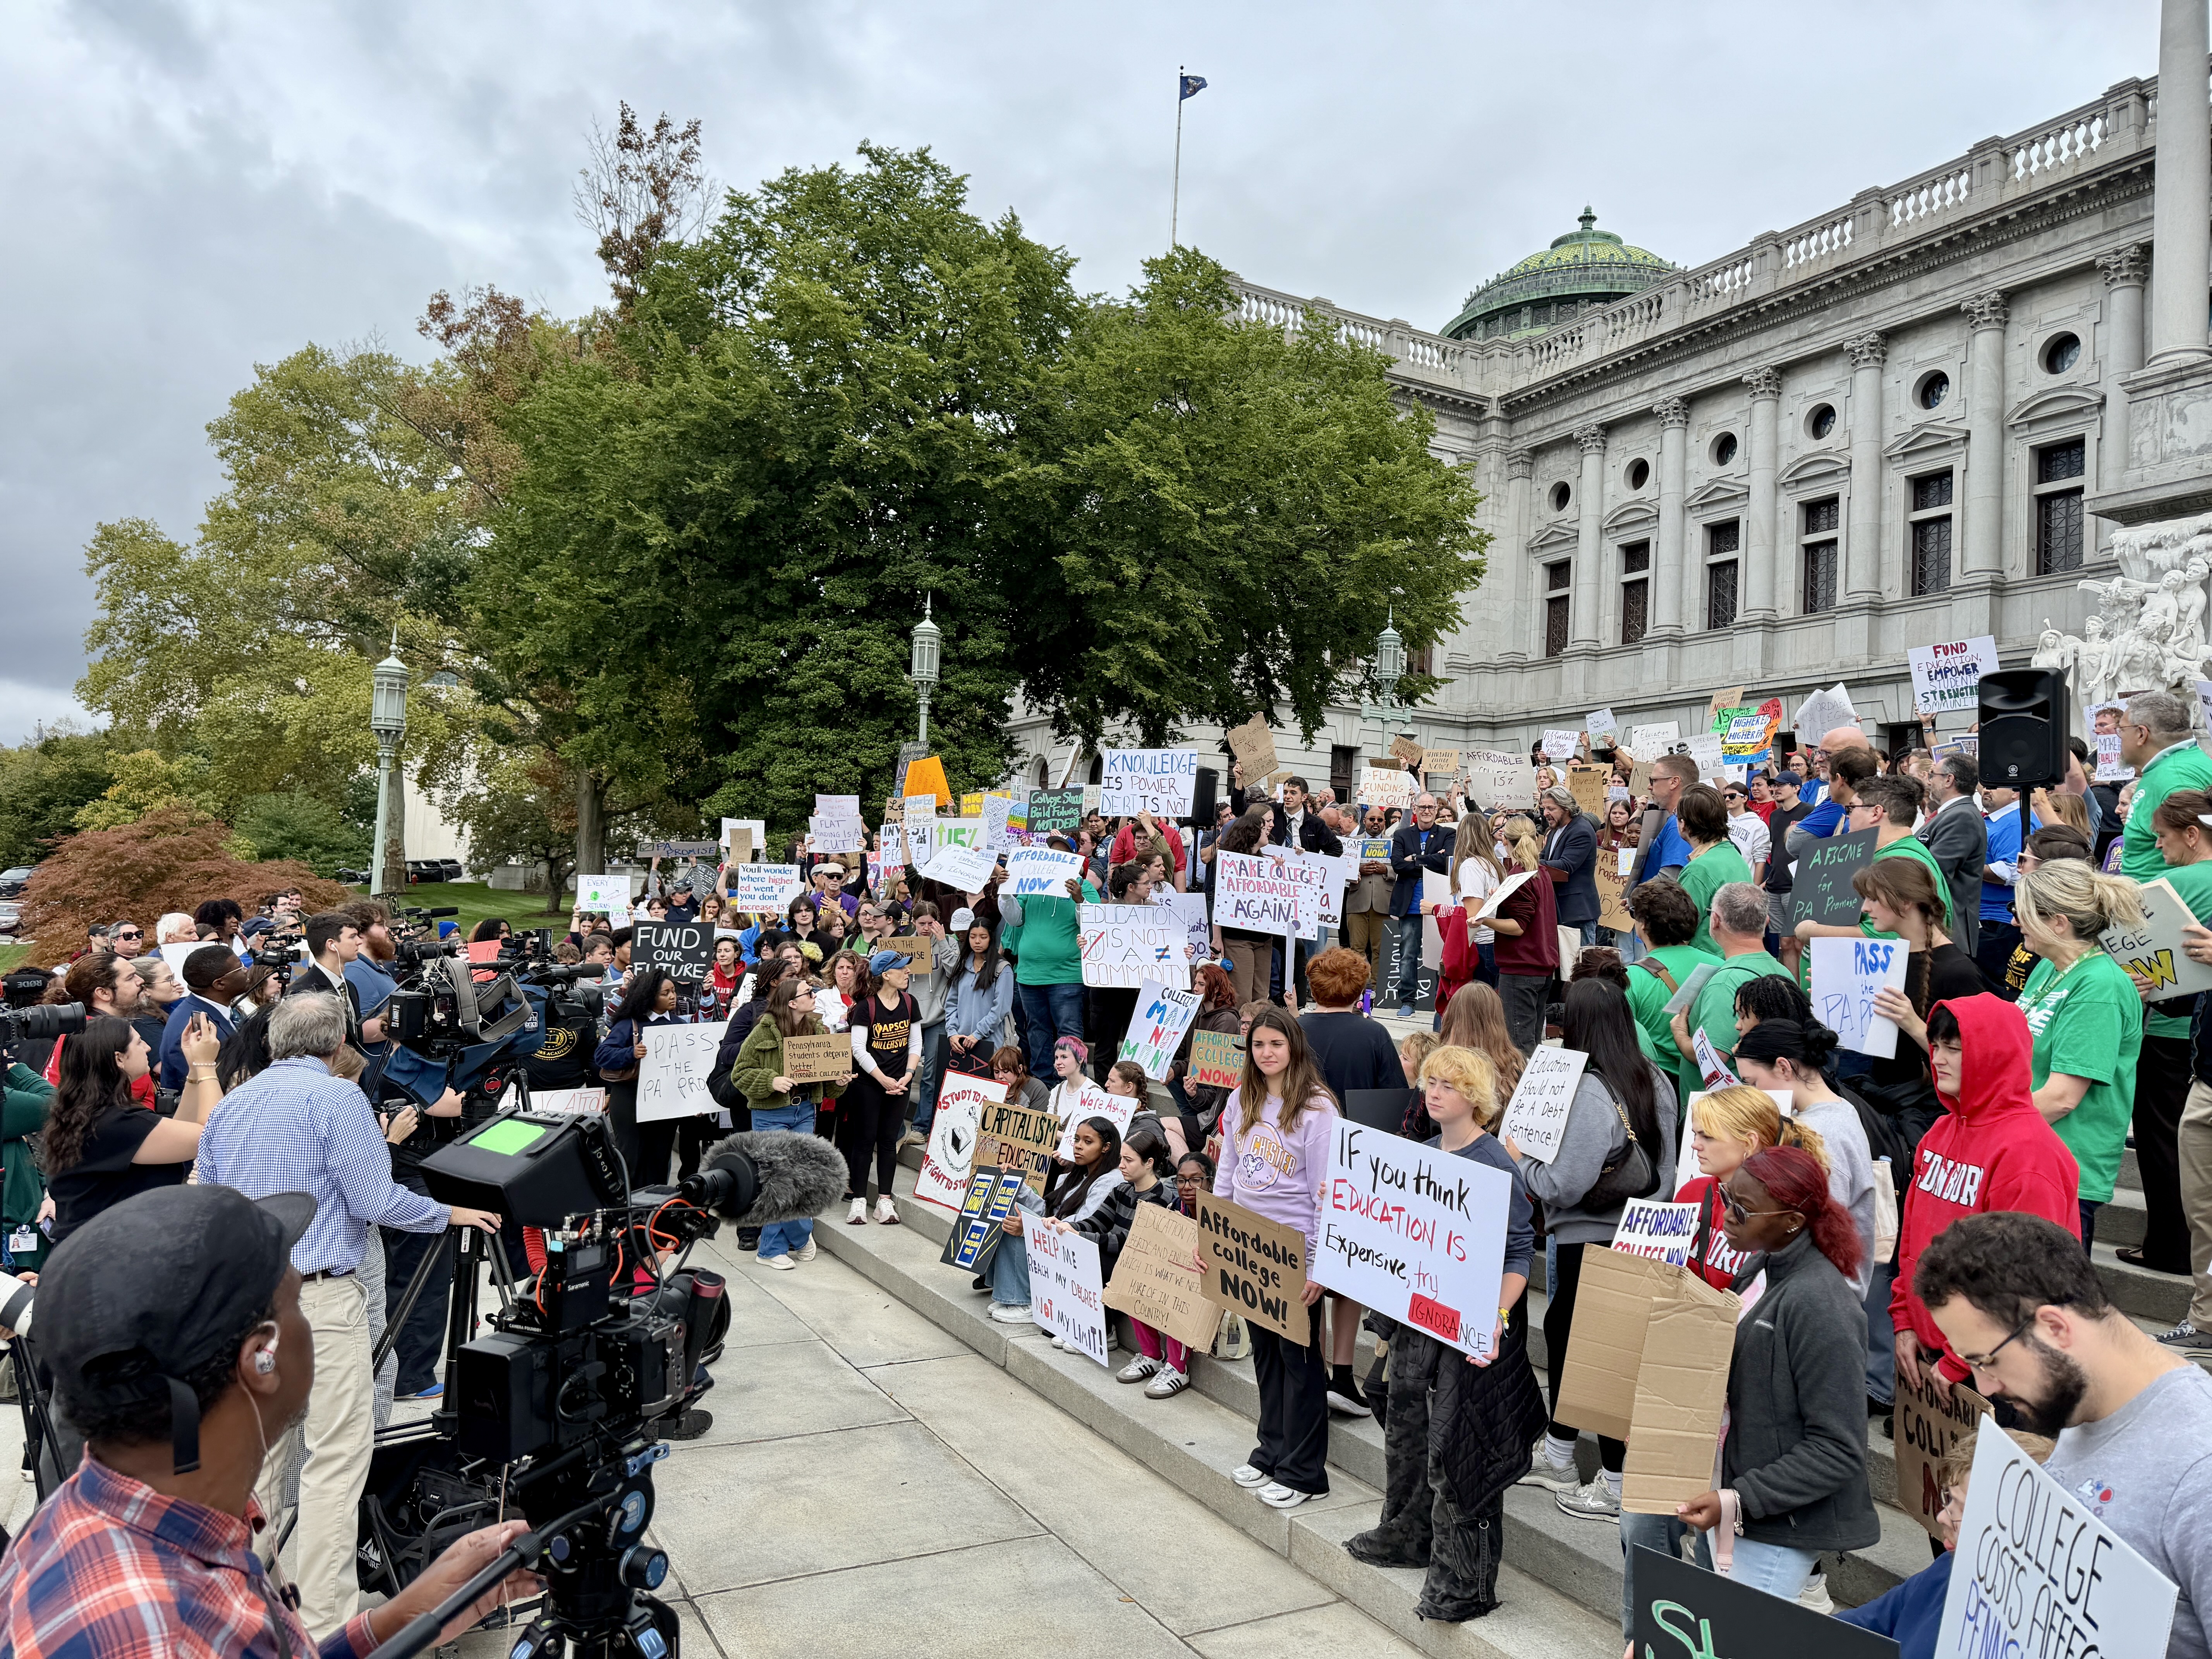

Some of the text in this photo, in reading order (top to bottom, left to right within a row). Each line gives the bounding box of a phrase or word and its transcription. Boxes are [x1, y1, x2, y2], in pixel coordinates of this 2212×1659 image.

[1932, 642, 1967, 659] FUND
[1927, 663, 1979, 681] EMPOWER
[1734, 715, 1769, 727] HIGHER ED
[1640, 728, 1669, 738] Education
[1728, 729, 1763, 740] HIGHER PA
[901, 742, 929, 754] Affordable
[1396, 738, 1420, 753] AFFORDABLE
[1399, 746, 1416, 756] COLLEGE
[2099, 737, 2118, 751] MAKE
[1109, 751, 1197, 775] KNOWLEDGE
[1467, 752, 1524, 765] AFFORDABLE
[1711, 757, 1723, 767] WE
[2098, 752, 2117, 763] EQUALLY
[1373, 770, 1400, 780] FLAT
[1494, 776, 1514, 787] 15%
[1571, 775, 1596, 786] Invest
[1103, 776, 1180, 795] IS POWER
[1364, 783, 1403, 793] FUNDING
[924, 795, 933, 805] Ed
[1100, 793, 1136, 813] DEBT
[1140, 795, 1159, 812] IS
[1166, 797, 1189, 815] NOT
[1386, 794, 1410, 805] CUT!
[1588, 805, 1597, 813] PA
[820, 820, 846, 828] FLAT
[905, 815, 922, 828] Higher
[1034, 818, 1057, 831] NOT
[1056, 816, 1081, 830] DEBT
[735, 833, 748, 842] Get
[814, 830, 840, 838] FUNDING
[854, 828, 860, 836] A
[1731, 824, 1750, 843] HAVEN
[657, 842, 671, 851] PA
[667, 847, 716, 856] PROMISE
[823, 839, 855, 850] CUT!
[1347, 839, 1362, 849] GSP
[1365, 848, 1388, 857] NOW!
[1011, 850, 1077, 865] AFFORDABLE
[1809, 842, 1866, 870] AFSCME
[933, 862, 987, 884] TRY IGNORANCE!
[1021, 863, 1060, 877] COLLEGE
[1221, 859, 1319, 886] MAKE COLLEGE
[768, 876, 795, 886] higher
[779, 885, 785, 893] if
[1016, 878, 1054, 893] NOW
[1227, 877, 1302, 898] AFFORDABLE
[1818, 873, 1832, 893] for
[740, 893, 756, 901] you
[1082, 905, 1185, 925] EDUCATION
[1793, 895, 1858, 922] PA Promise
[637, 926, 700, 949] FUND
[880, 940, 915, 949] PASS THE
[1106, 929, 1123, 948] IS
[1131, 929, 1171, 945] NOT
[653, 950, 684, 962] OUR
[1121, 947, 1143, 962] A
[1855, 941, 1894, 975] PASS
[1085, 963, 1188, 988] COMMODITY
[1416, 979, 1431, 1000] PA
[1861, 979, 1874, 994] the
[1821, 993, 1854, 1034] PA
[654, 1032, 714, 1060] PASS
[788, 1040, 832, 1051] Pennsylvania
[1148, 1025, 1179, 1050] NOT
[546, 1045, 570, 1056] ACADEMY
[789, 1050, 849, 1061] students deserve
[1196, 1046, 1245, 1070] COLLEGE
[660, 1061, 693, 1077] THE
[790, 1060, 816, 1071] better!
[1530, 1051, 1570, 1074] Education
[790, 1070, 817, 1079] AFFORDABLE
[1199, 1068, 1237, 1087] NOW!
[644, 1079, 661, 1102] PA
[1520, 1079, 1565, 1096] Should not
[973, 1091, 980, 1103] TO
[1080, 1090, 1127, 1122] We're Asking
[1513, 1099, 1564, 1119] Be A Debt
[1509, 1120, 1560, 1147] Sentence!!
[997, 1142, 1051, 1175] EDUCATION
[1250, 1135, 1297, 1179] CHESTER
[1027, 1174, 1044, 1183] produce
[1340, 1127, 1472, 1222] IF you think
[1136, 1206, 1187, 1239] EDUCATION
[1332, 1179, 1466, 1261] EDUCATION IS
[1621, 1206, 1697, 1237] AFFORDABLE
[1200, 1205, 1298, 1270] Affordable
[1032, 1228, 1077, 1269] HELP ME
[1152, 1243, 1168, 1259] AND
[1120, 1252, 1185, 1287] WHICH IS WHAT WE
[1213, 1242, 1281, 1288] college
[1326, 1224, 1438, 1300] Expensive, try
[568, 1280, 590, 1291] Saramonic
[1027, 1253, 1098, 1311] REACH MY DEGREE
[1128, 1279, 1190, 1315] MORE OF IN THIS
[1220, 1269, 1288, 1329] NOW!
[1133, 1299, 1170, 1328] COUNTRY!
[1036, 1295, 1103, 1356] NOT MY LIMIT!
[1412, 1298, 1488, 1353] IGNORANCE
[1997, 1458, 2113, 1632] COLLEGE
[1977, 1525, 2027, 1630] COSTS
